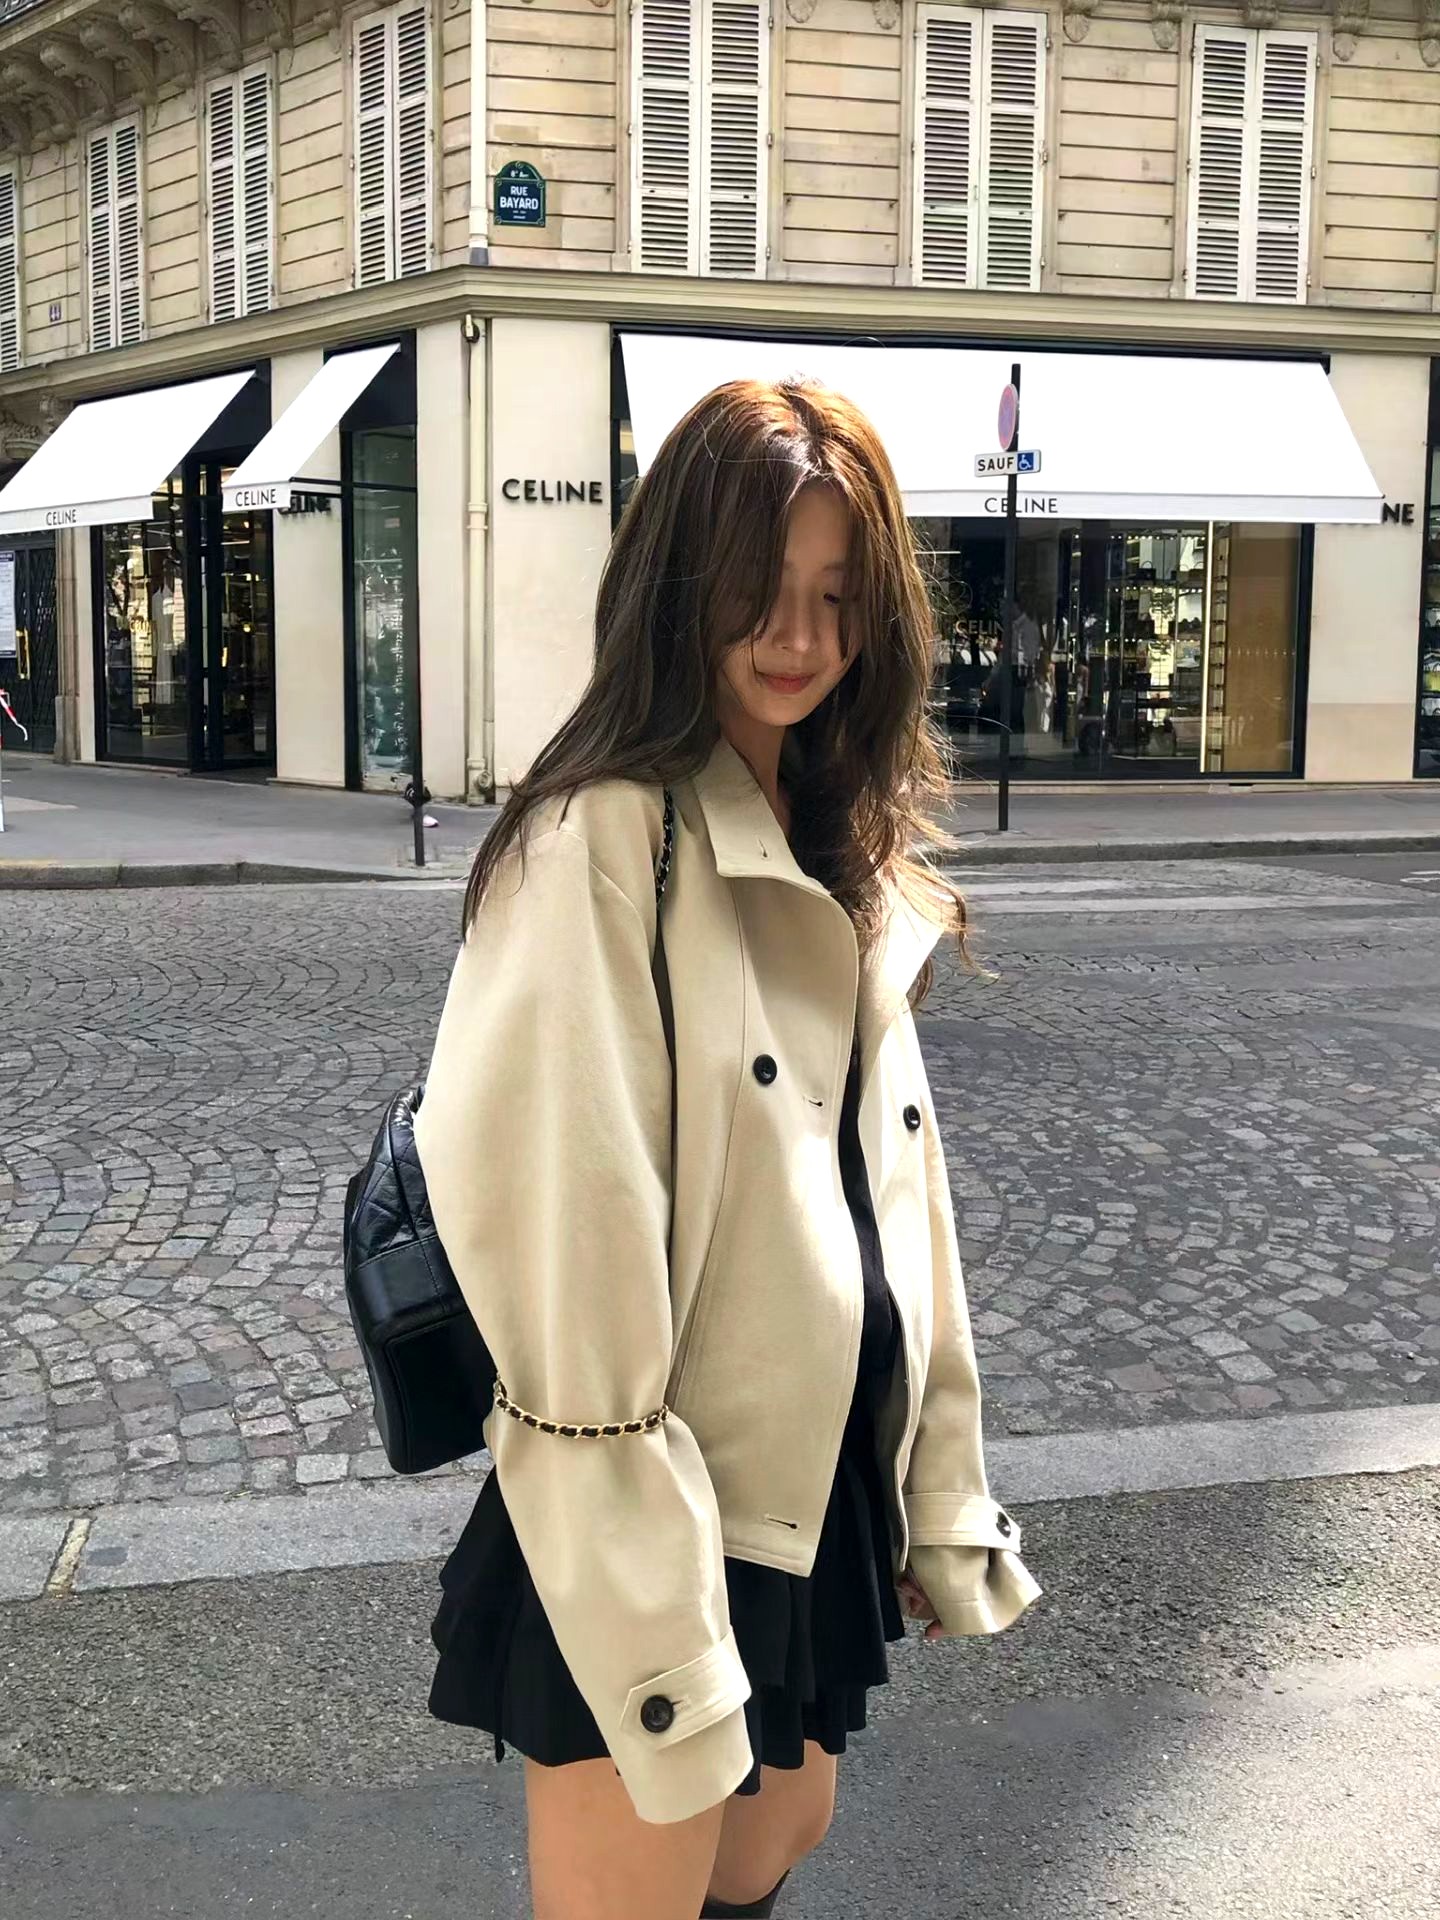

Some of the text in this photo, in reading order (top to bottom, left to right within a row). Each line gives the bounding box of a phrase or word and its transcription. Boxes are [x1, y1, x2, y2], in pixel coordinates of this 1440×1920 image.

[510, 186, 529, 196] RUE
[500, 196, 539, 210] BAYARD
[977, 456, 1015, 472] SAUF
[235, 488, 277, 507] CELINE
[502, 478, 603, 504] CELINE
[277, 495, 332, 515] ELINE
[46, 509, 77, 525] CELINE
